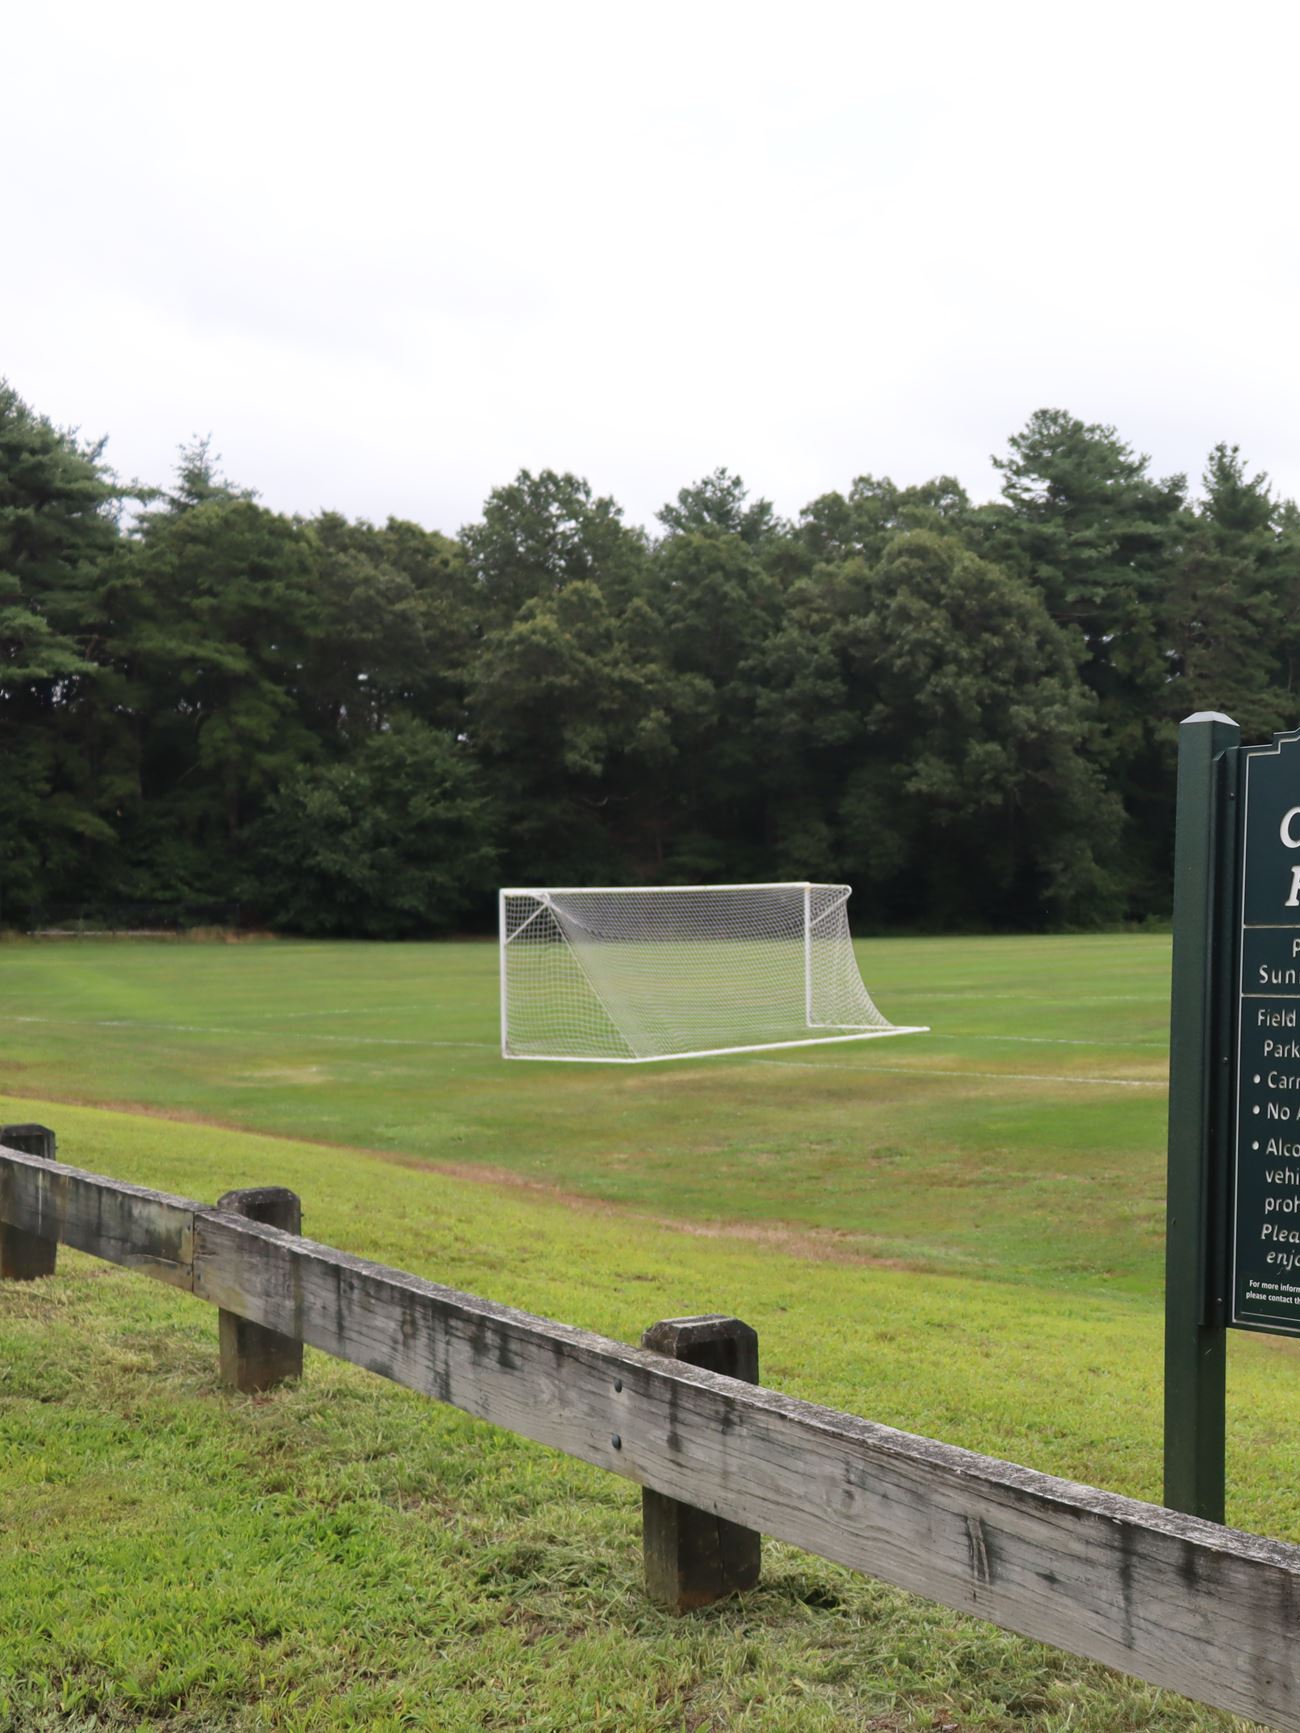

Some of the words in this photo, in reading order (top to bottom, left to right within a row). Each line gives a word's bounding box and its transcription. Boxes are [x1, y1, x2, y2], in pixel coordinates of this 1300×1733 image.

[1257, 1009, 1296, 1027] Field
[1267, 1102, 1290, 1120] No
[1246, 1291, 1266, 1300] please
[1268, 1295, 1292, 1304] contact
